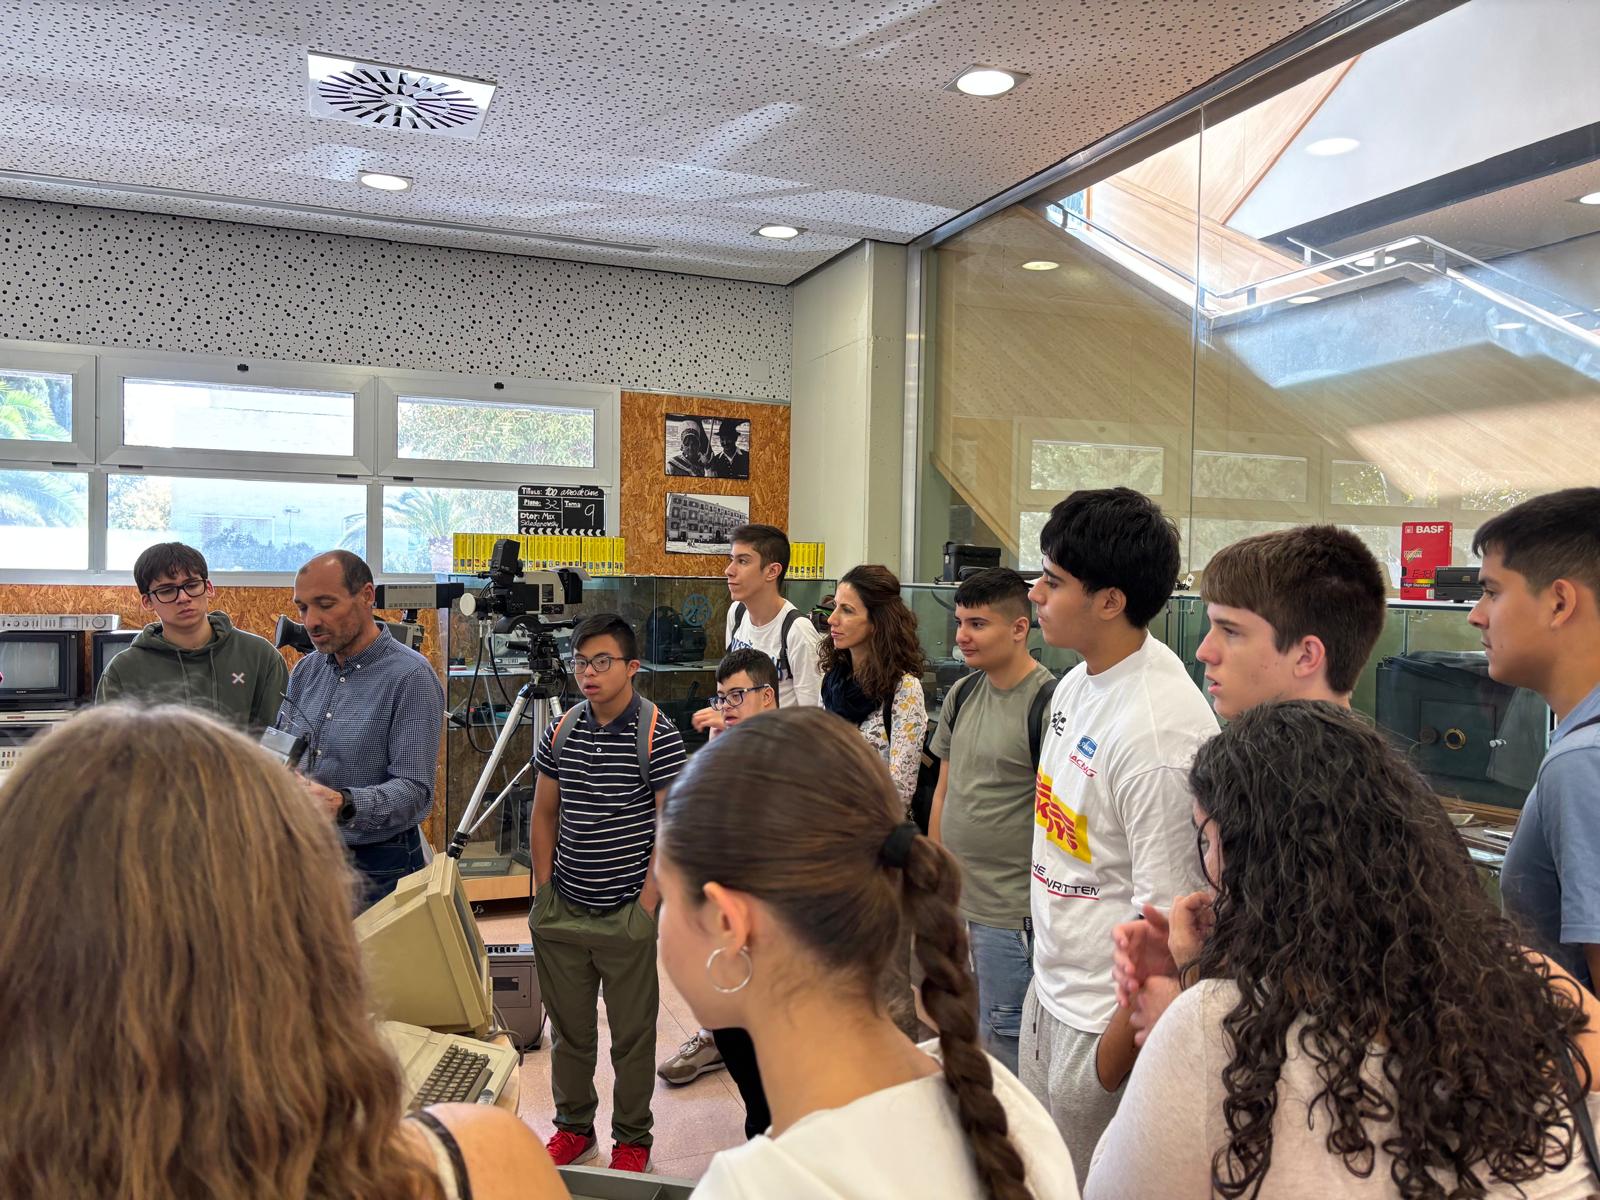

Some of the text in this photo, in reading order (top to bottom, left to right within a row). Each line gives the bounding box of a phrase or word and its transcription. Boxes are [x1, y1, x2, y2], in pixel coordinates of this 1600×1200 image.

[545, 487, 558, 496] 100
[545, 499, 559, 509] 32
[584, 504, 595, 526] 9
[1032, 861, 1046, 876] HE
